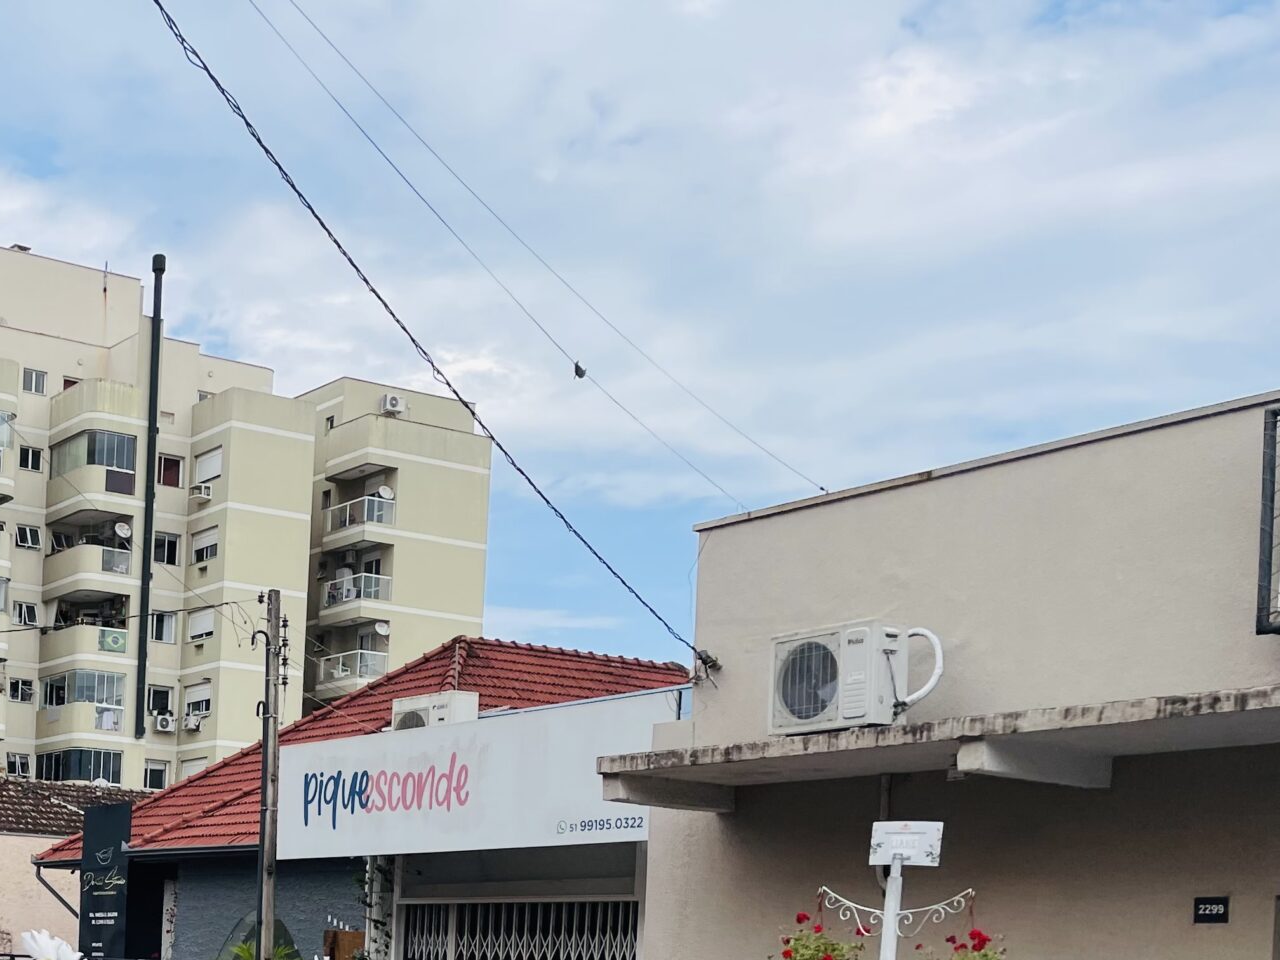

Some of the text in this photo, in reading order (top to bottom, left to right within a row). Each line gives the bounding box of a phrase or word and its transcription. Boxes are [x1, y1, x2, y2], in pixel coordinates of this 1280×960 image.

[569, 816, 644, 832] 51 99195.0322
[1198, 904, 1225, 914] 2299
